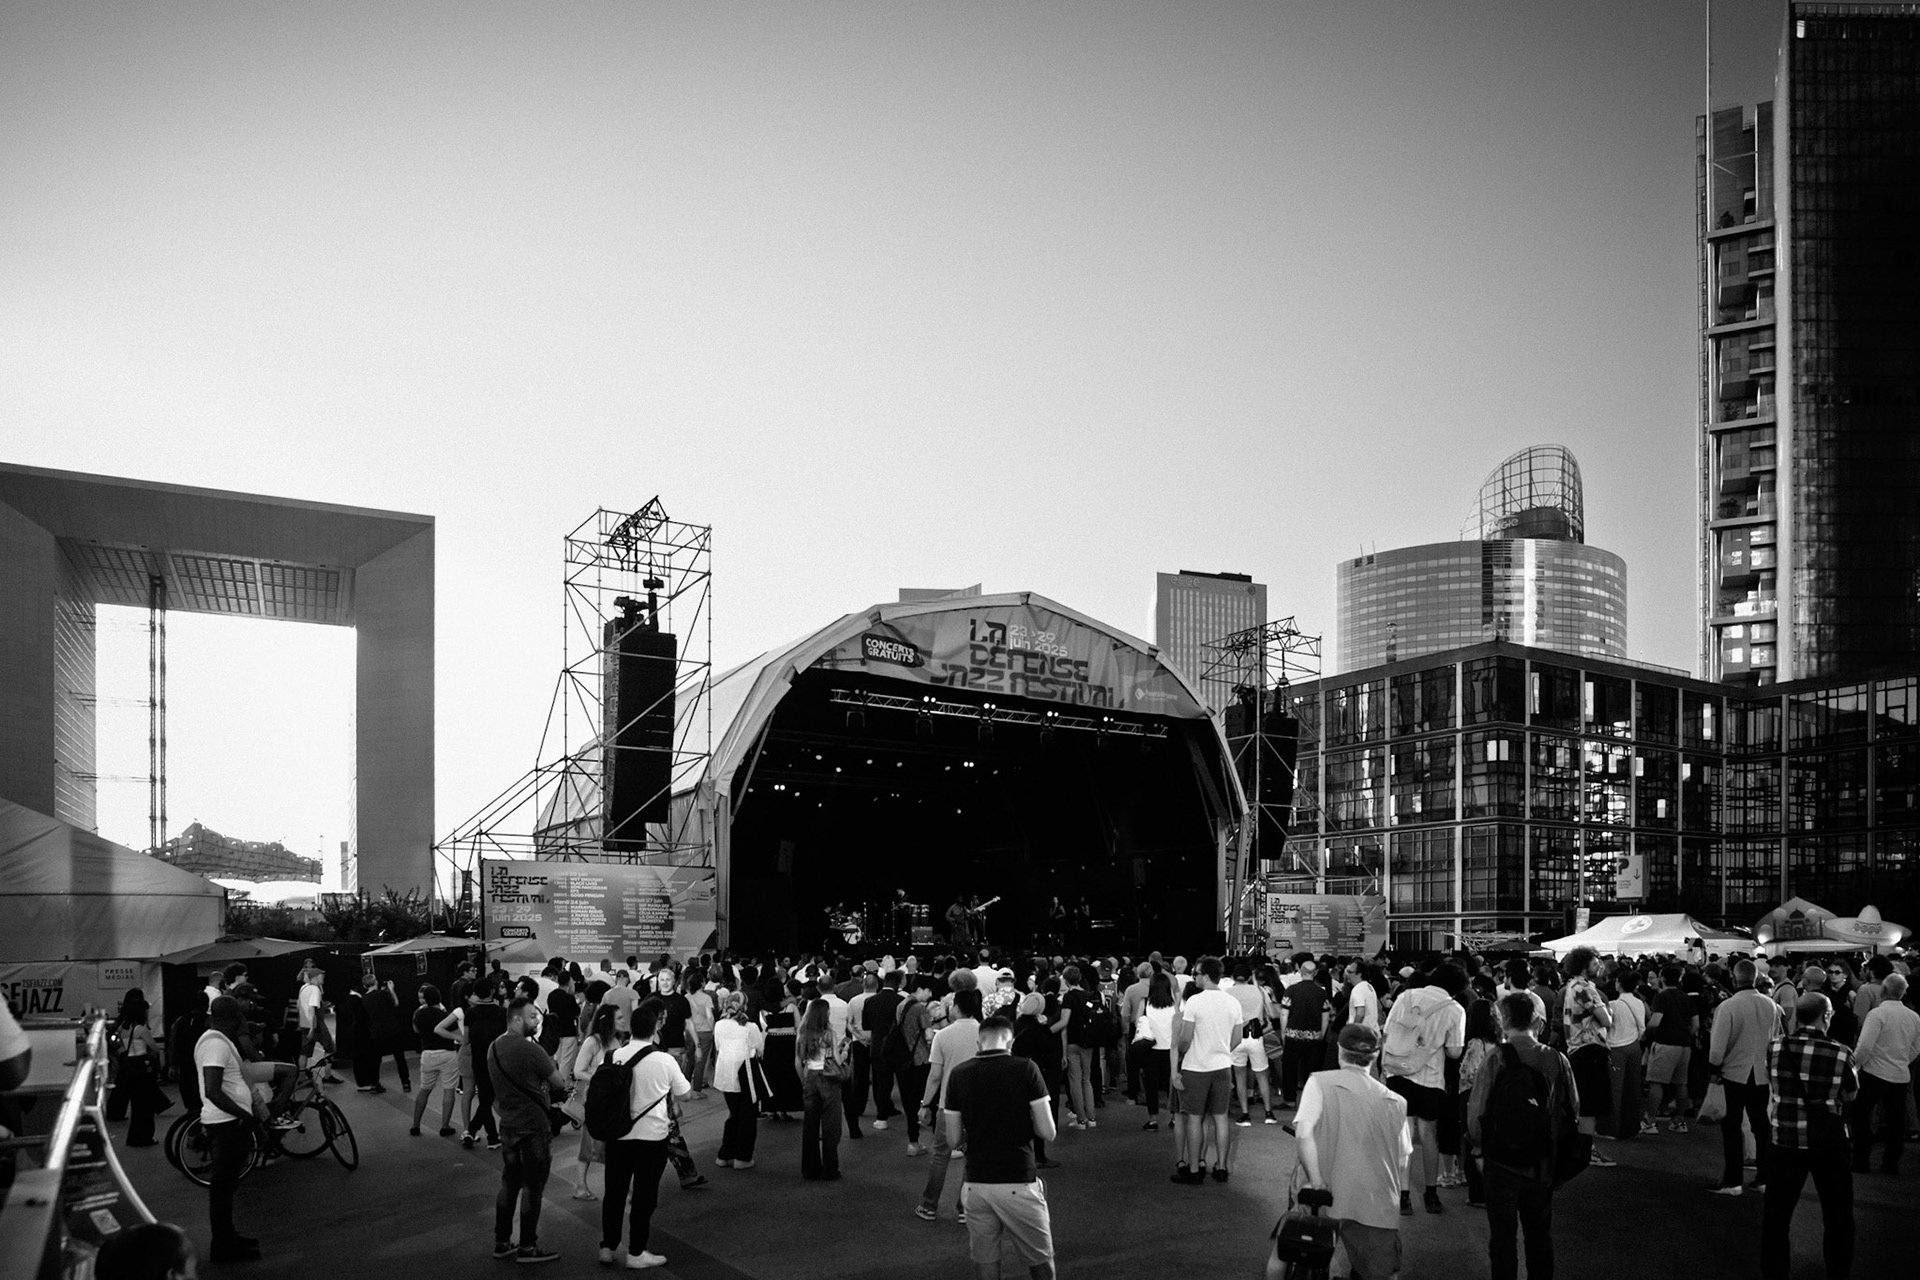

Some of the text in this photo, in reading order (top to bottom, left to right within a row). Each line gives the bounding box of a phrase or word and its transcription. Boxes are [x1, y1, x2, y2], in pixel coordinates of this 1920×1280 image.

[970, 619, 1007, 645] LA
[1009, 625, 1028, 637] 23
[1037, 630, 1057, 643] 29
[865, 637, 915, 656] CONCERTS
[867, 647, 915, 663] GRATUITS
[1009, 636, 1068, 657] juin 2025
[930, 663, 1125, 709] JAZZ FESTIVAL
[491, 866, 508, 875] LA
[487, 885, 520, 893] JAZZ
[492, 905, 532, 914] 23 29
[492, 913, 543, 923] juin 2025
[22, 988, 63, 1014] JAZZ
